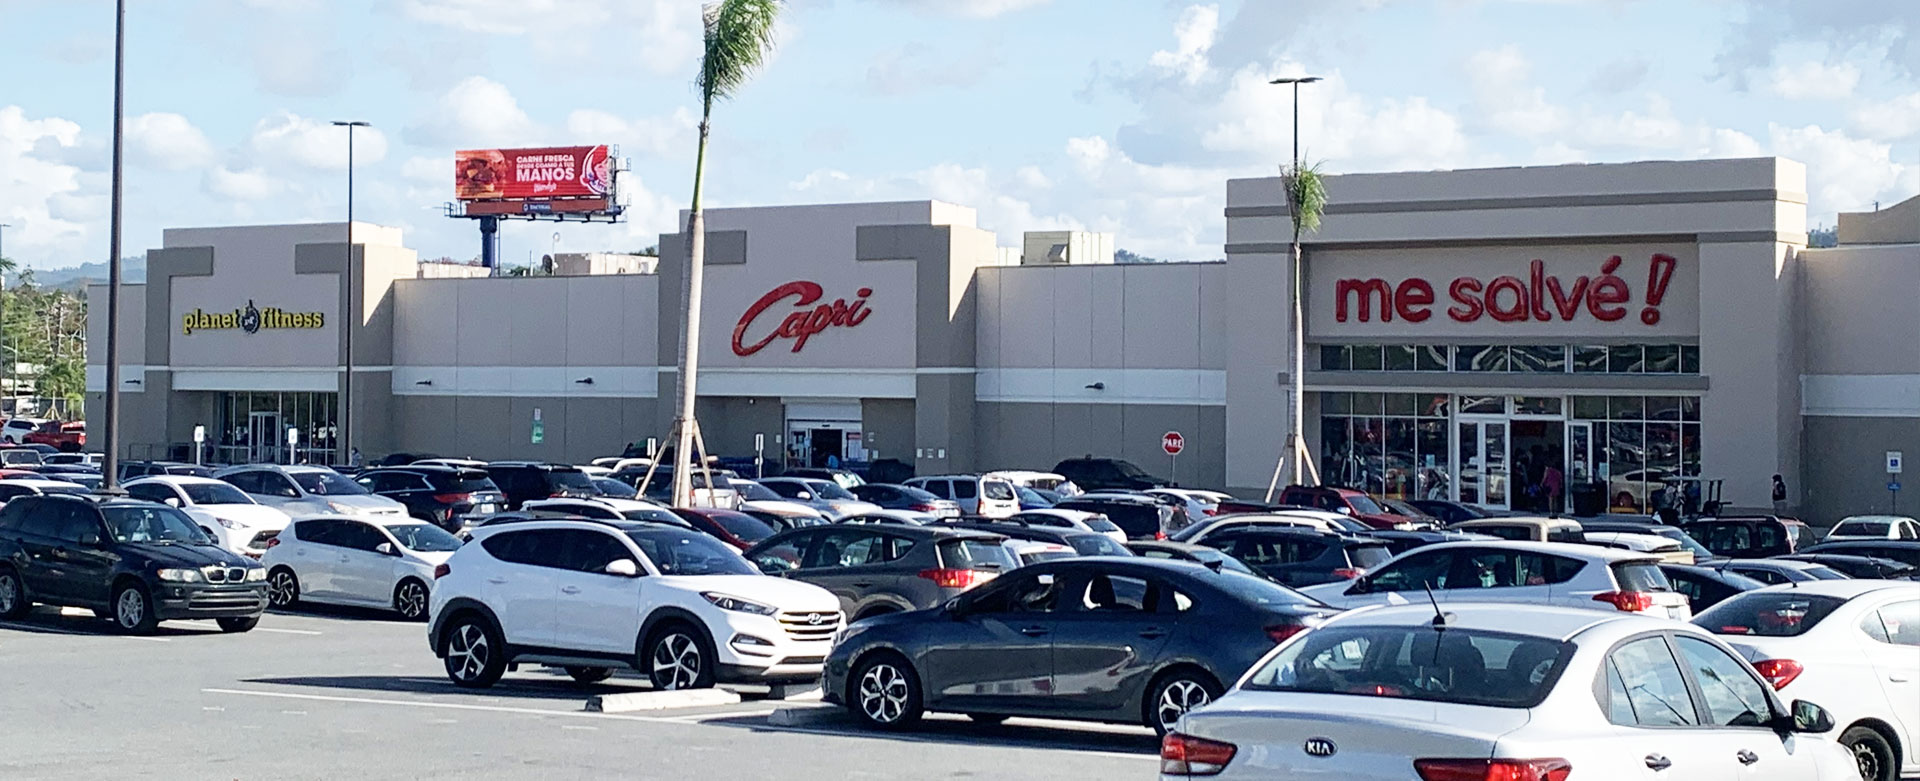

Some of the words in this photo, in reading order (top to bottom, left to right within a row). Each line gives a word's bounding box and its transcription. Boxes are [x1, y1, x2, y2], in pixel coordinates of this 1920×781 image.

[516, 155, 543, 163] CARNE
[516, 168, 575, 181] MANOS
[1335, 277, 1435, 323] me
[183, 308, 240, 335] planet
[260, 307, 325, 329] fitness
[731, 280, 873, 357] Capri
[1163, 438, 1183, 449] PARE
[1307, 741, 1331, 755] KIA
